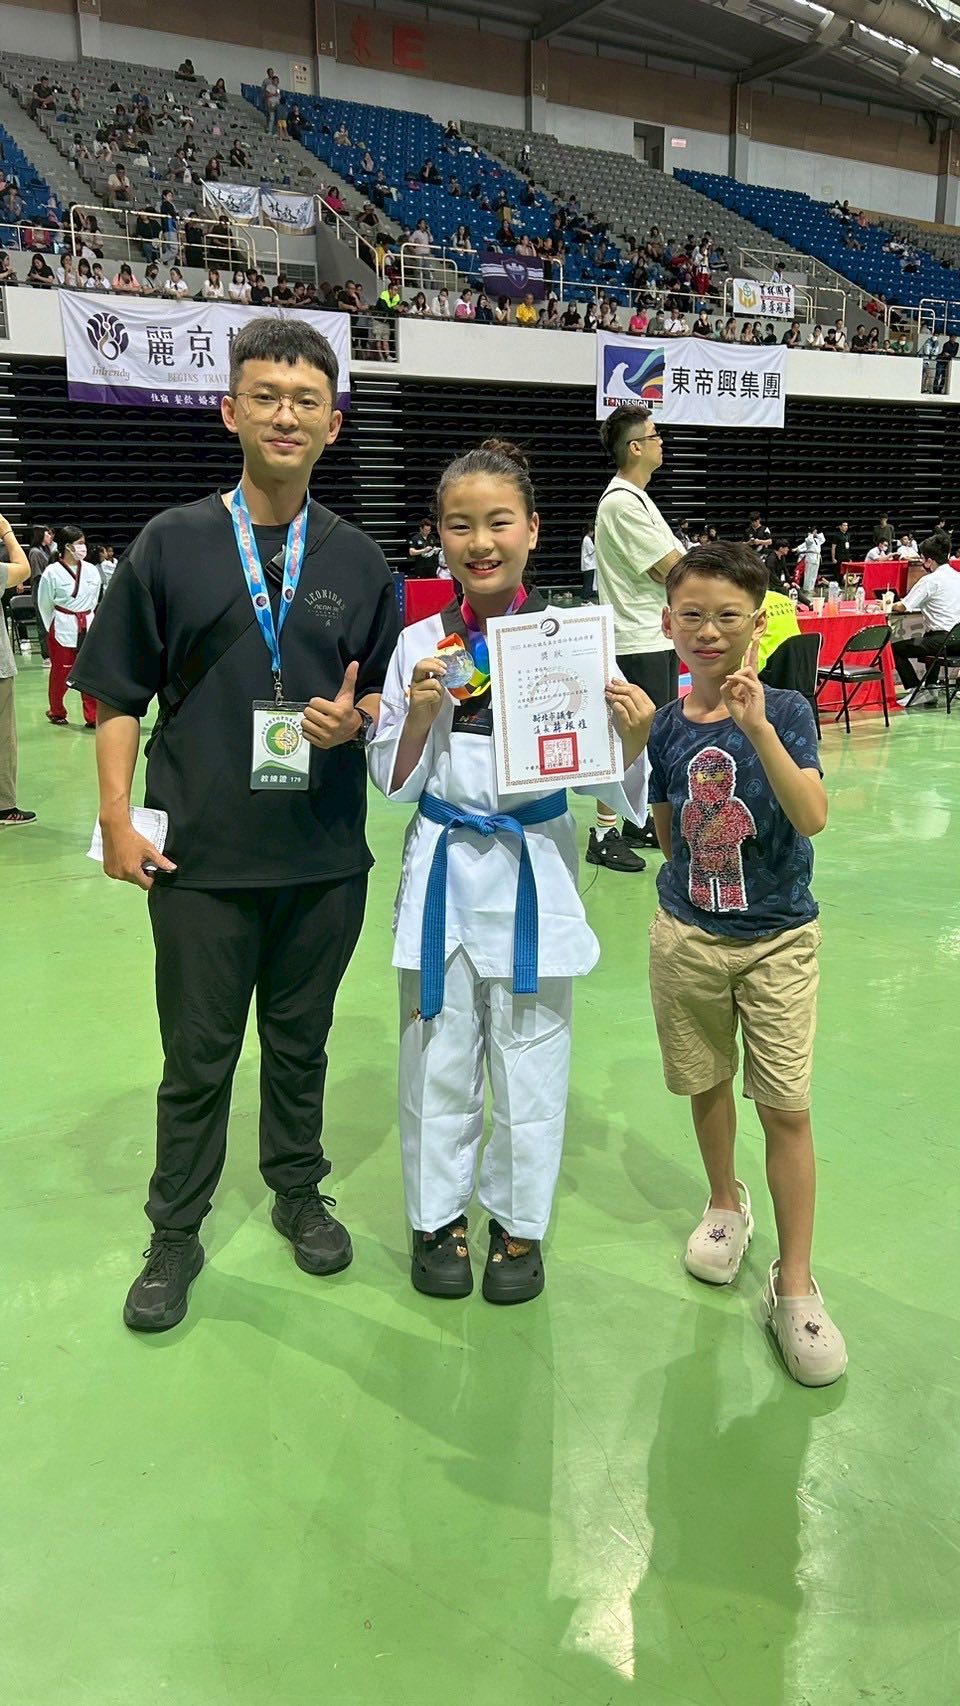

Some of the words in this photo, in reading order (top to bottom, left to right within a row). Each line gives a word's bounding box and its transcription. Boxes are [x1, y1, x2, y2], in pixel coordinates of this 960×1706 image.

[392, 24, 427, 71] E
[167, 372, 199, 383] BEGINS
[671, 366, 781, 400] 東帝興集團
[150, 393, 169, 403] 住宿
[532, 710, 575, 723] 新北市議會
